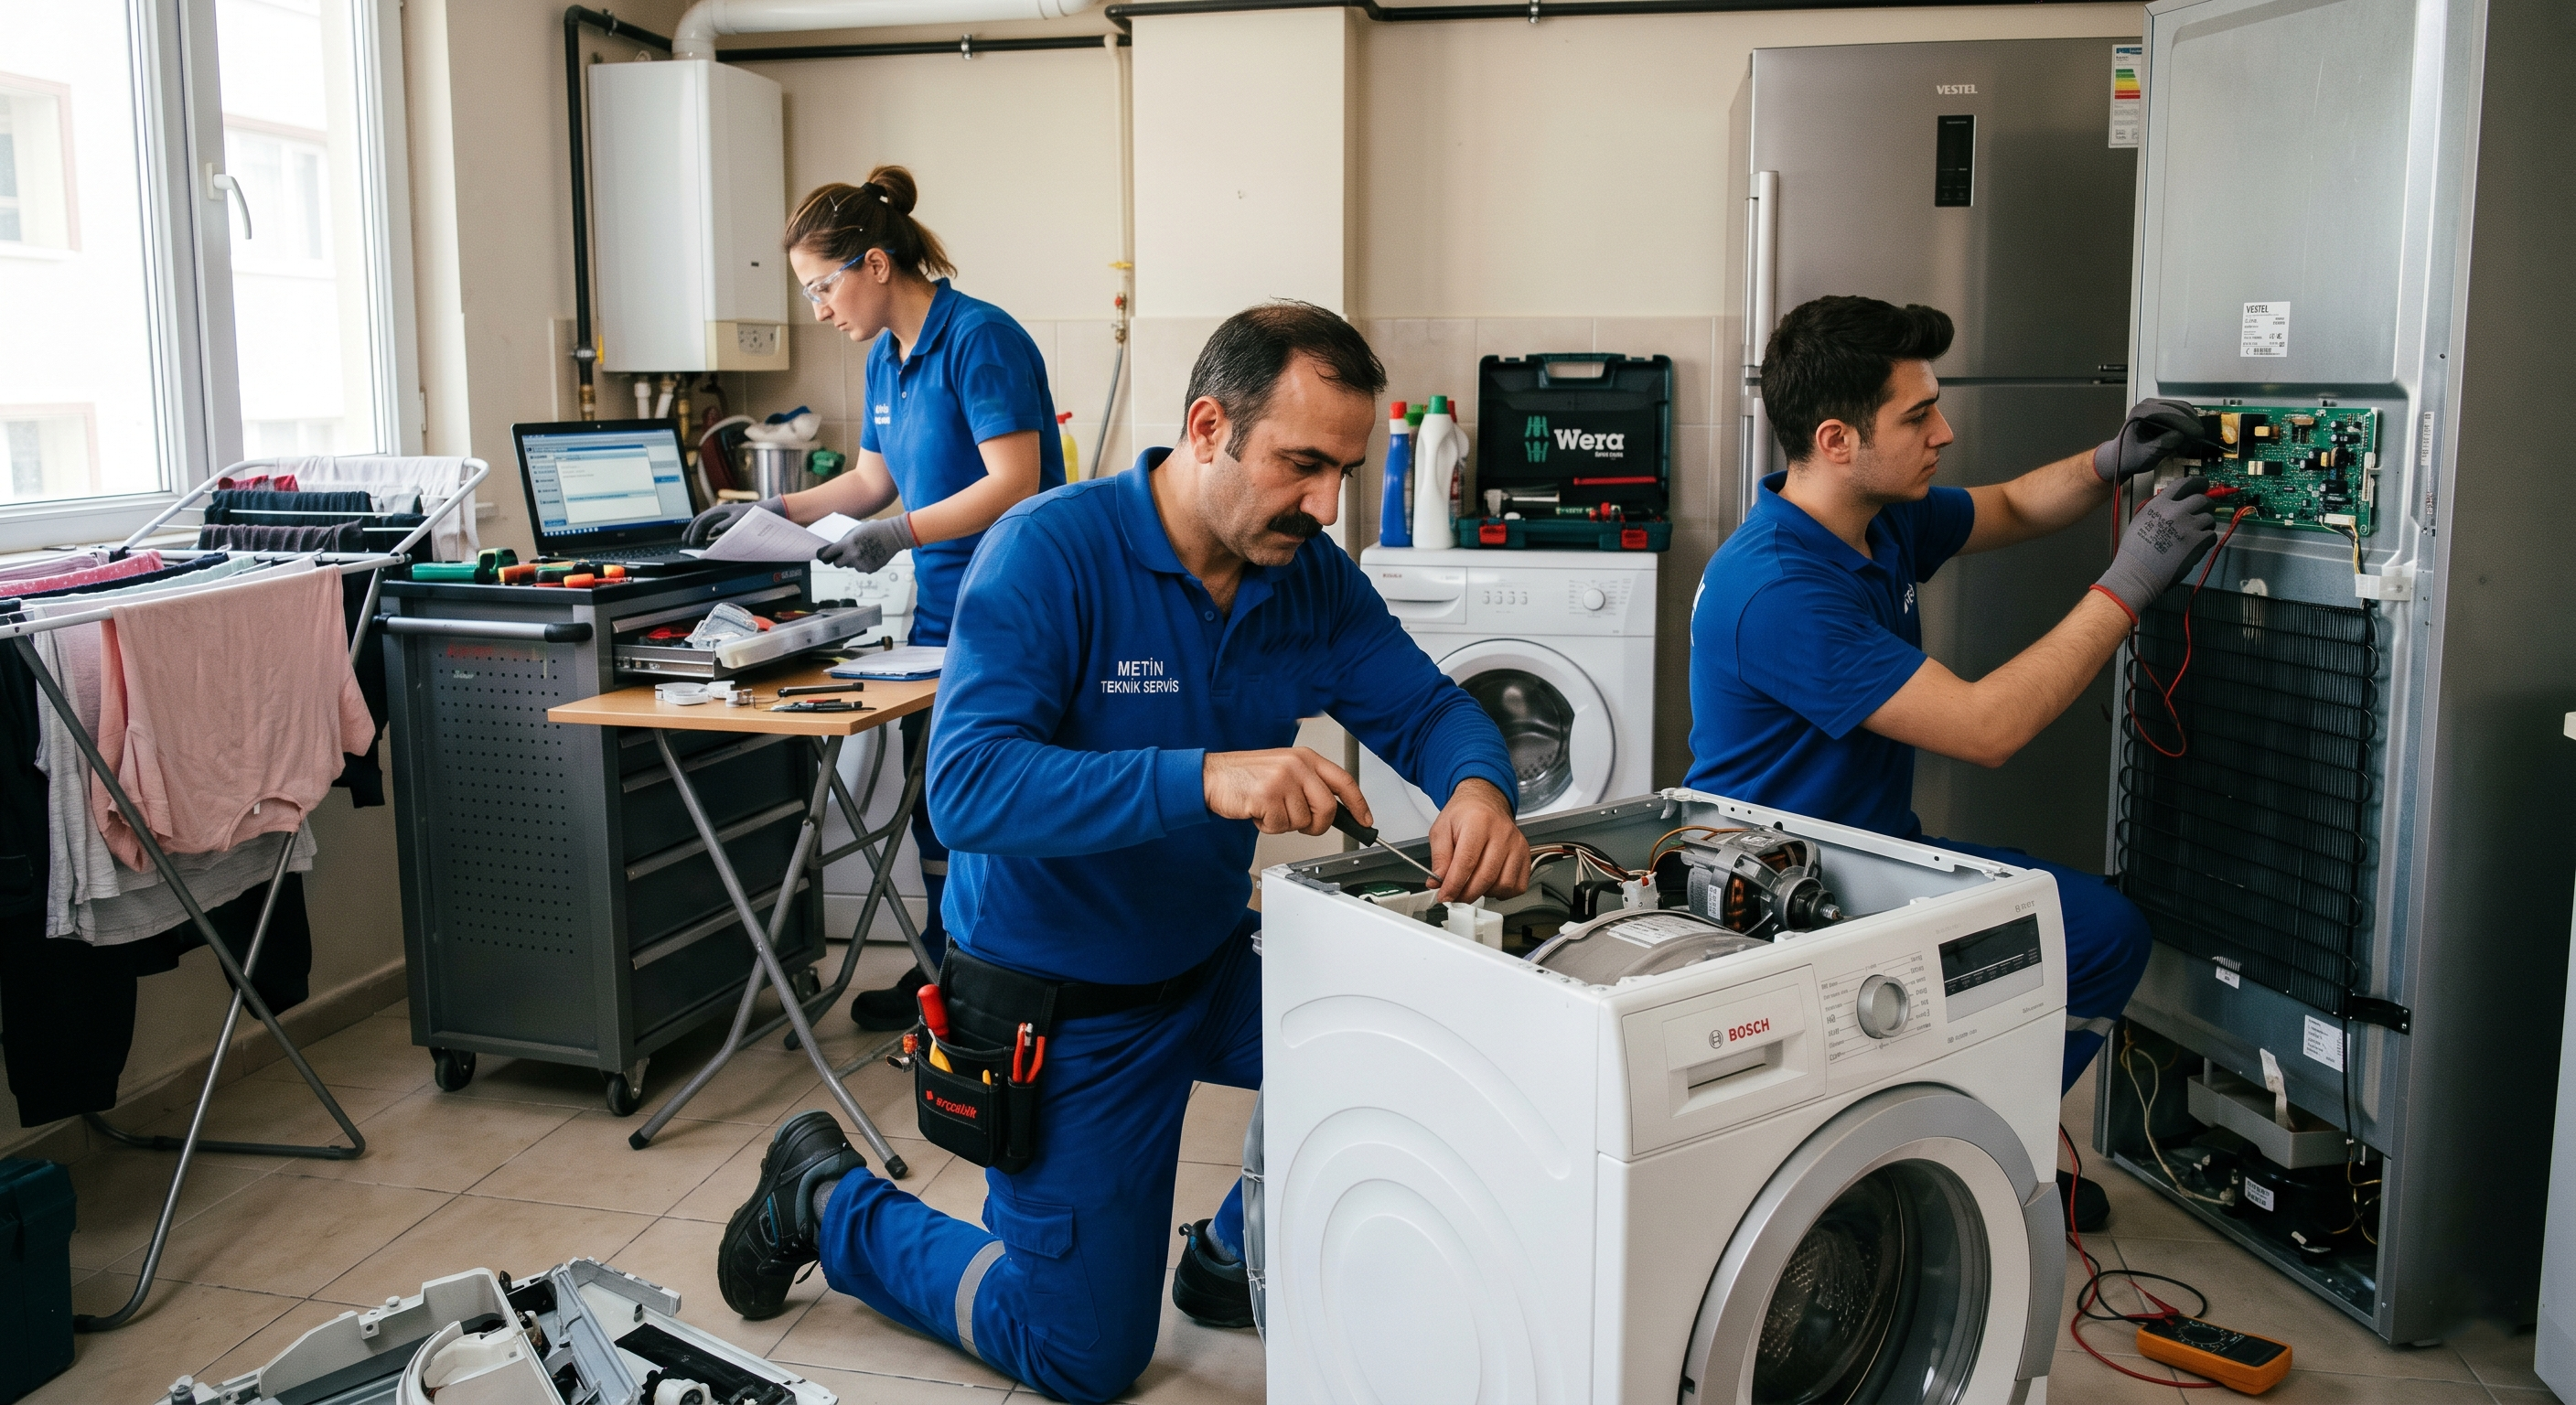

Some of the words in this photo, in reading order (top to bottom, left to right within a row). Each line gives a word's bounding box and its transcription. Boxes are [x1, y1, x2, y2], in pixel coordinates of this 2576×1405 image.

[1937, 84, 1978, 94] VESTEL
[2246, 305, 2269, 314] VESTEL
[1553, 428, 1625, 451] Wera
[1118, 657, 1164, 677] METİN
[1100, 677, 1141, 693] TEKNİK
[1143, 677, 1179, 692] SERVİS
[1728, 1017, 1770, 1042] BOSCH
